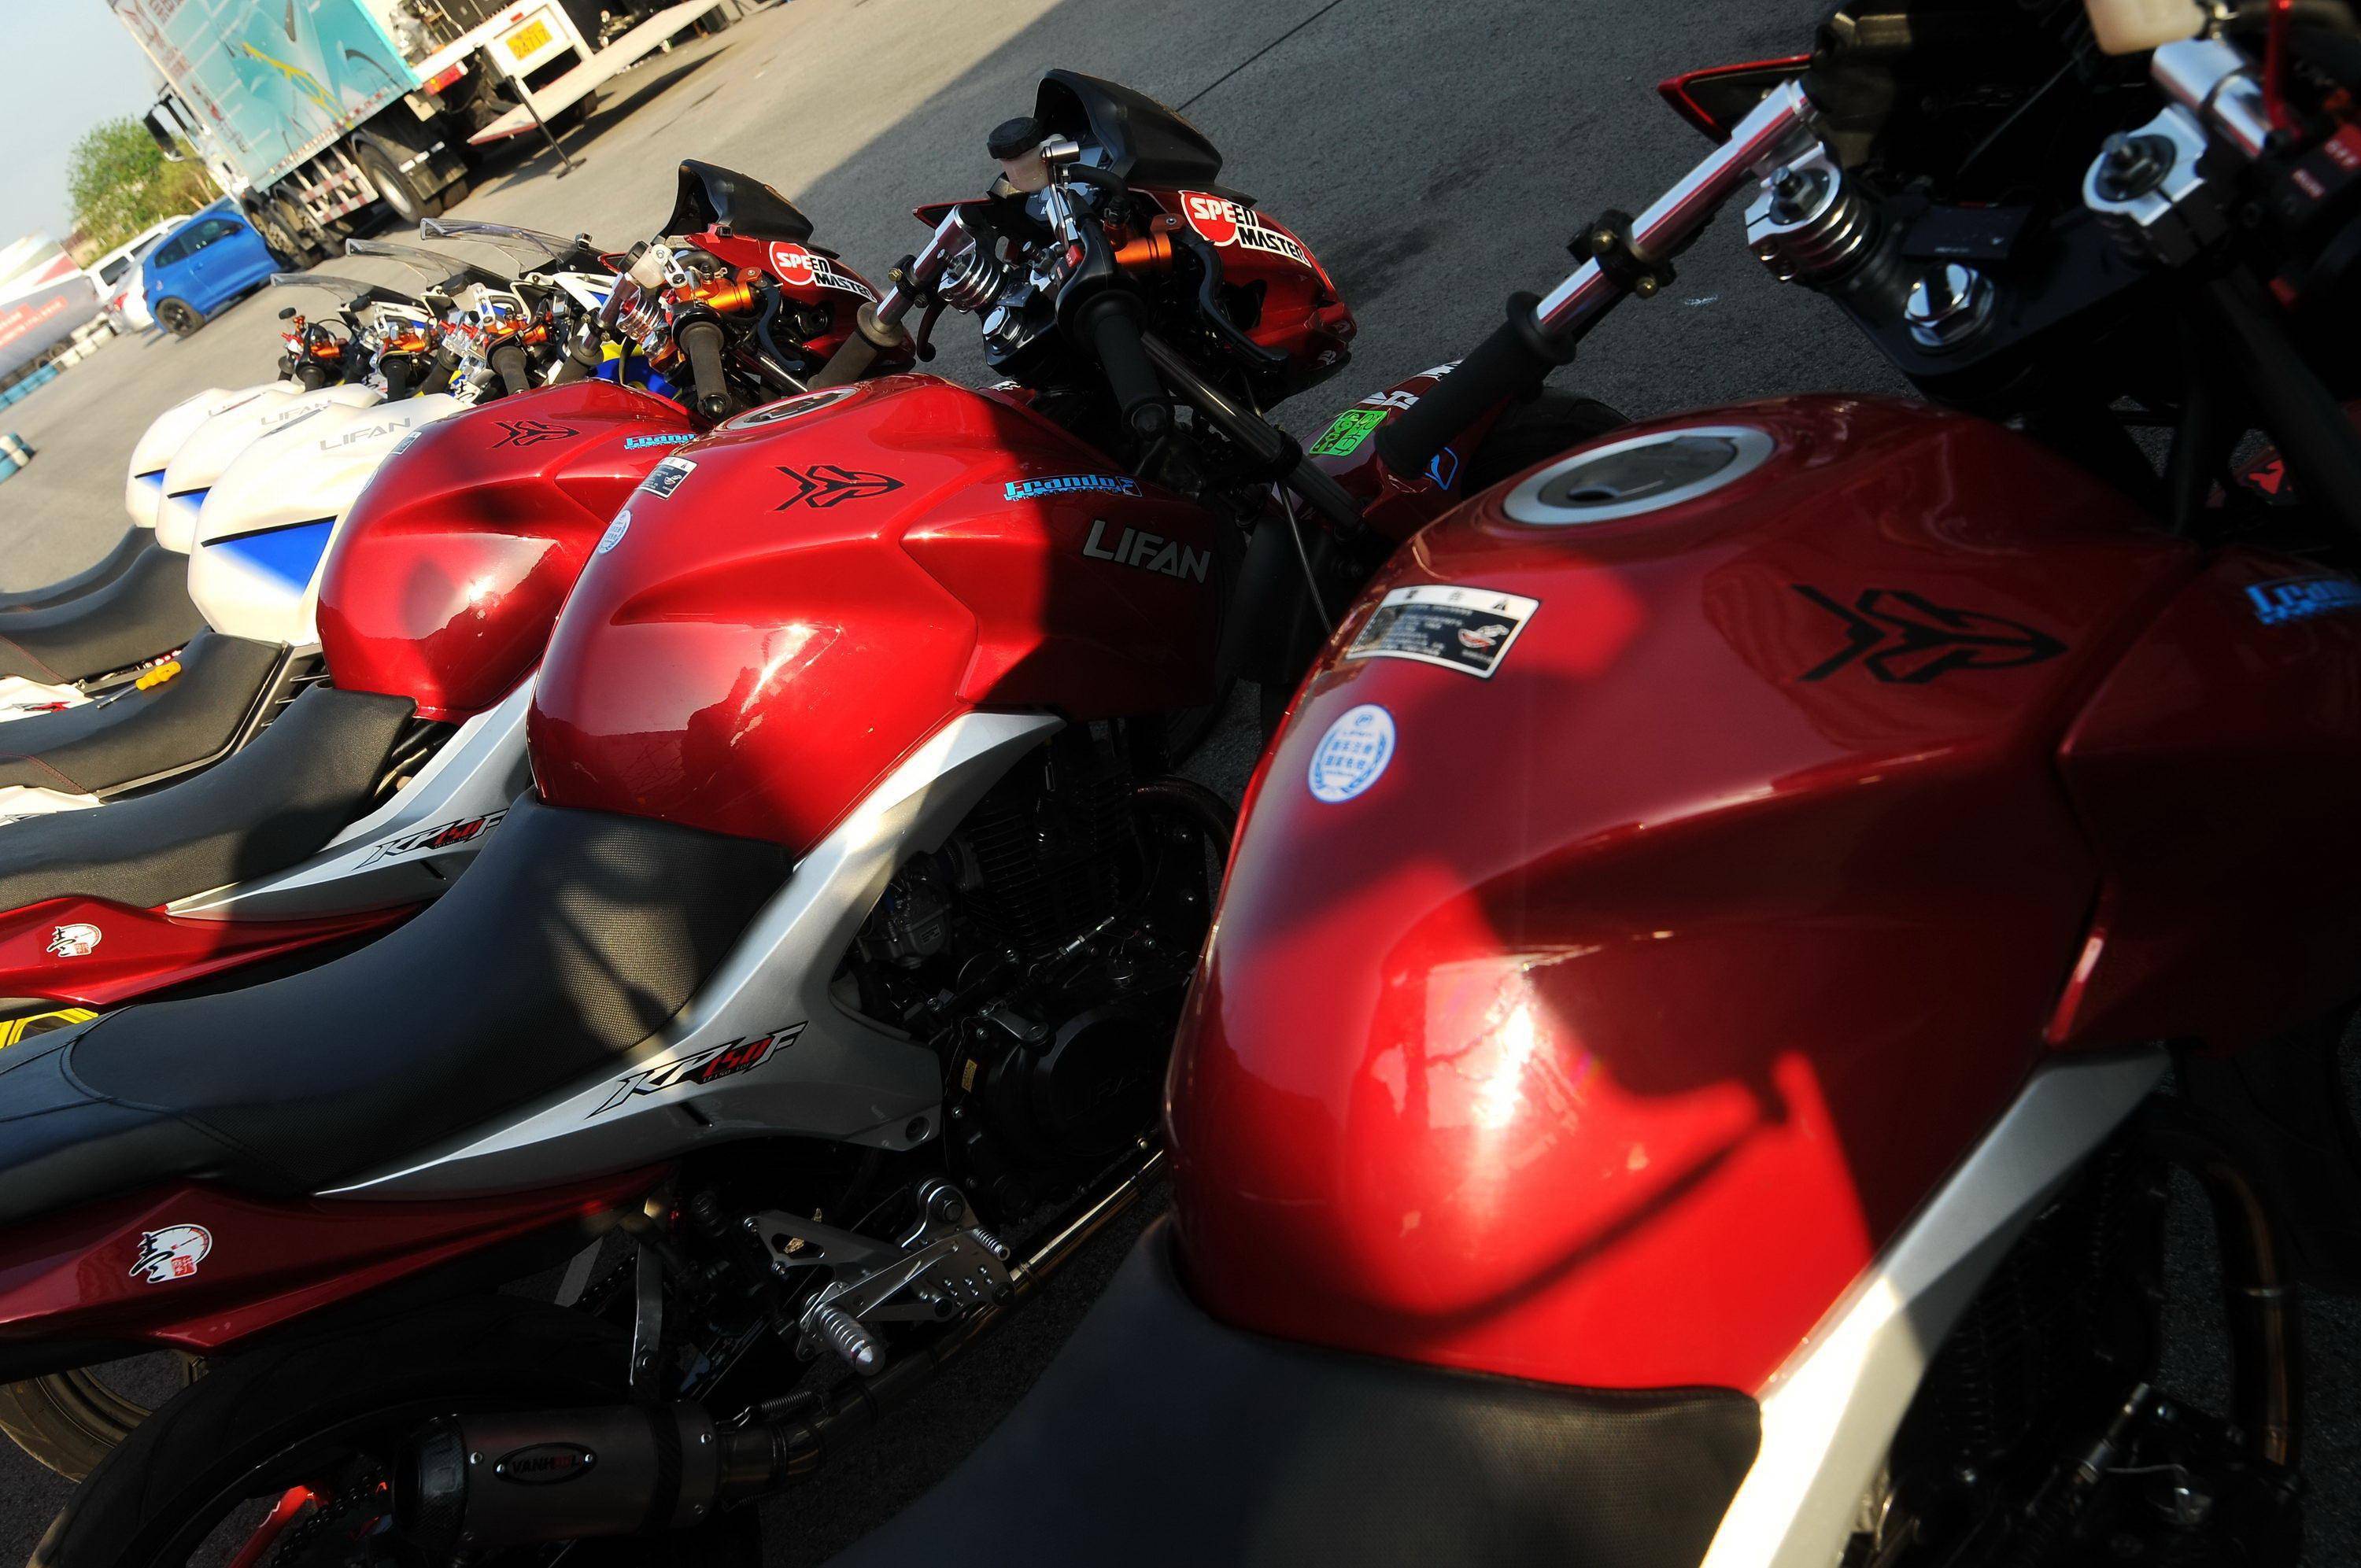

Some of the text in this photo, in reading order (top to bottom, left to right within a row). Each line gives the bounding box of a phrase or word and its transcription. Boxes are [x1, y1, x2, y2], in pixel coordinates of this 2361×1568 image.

[1190, 197, 1257, 227] SPEED
[1238, 226, 1307, 264] MASTER
[776, 251, 829, 274] SPEED
[814, 271, 875, 301] MASTER
[320, 418, 411, 452] LIFAN
[1083, 519, 1211, 584] LIFAN
